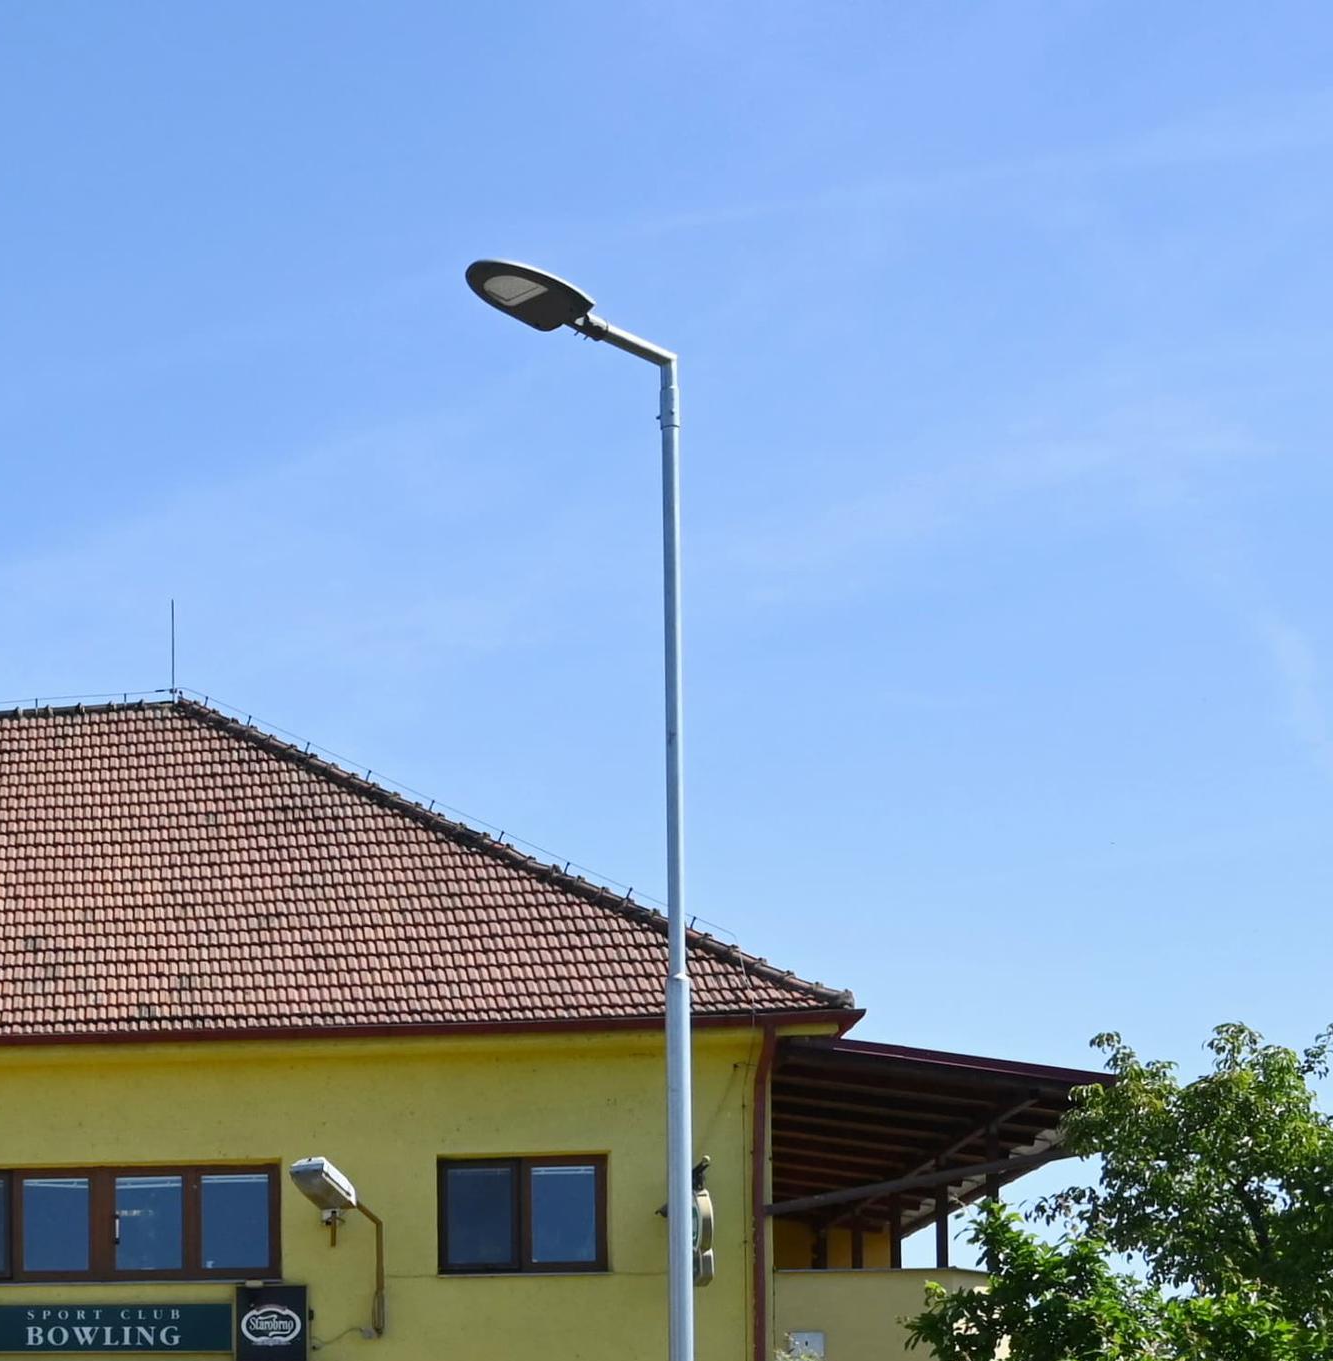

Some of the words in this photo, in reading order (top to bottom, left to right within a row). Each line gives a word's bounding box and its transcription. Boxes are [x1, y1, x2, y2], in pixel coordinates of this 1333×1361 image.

[26, 1309, 103, 1320] SPORT
[120, 1309, 181, 1320] CLUB
[25, 1325, 182, 1346] BOWLING
[249, 1314, 294, 1337] Starobrno
